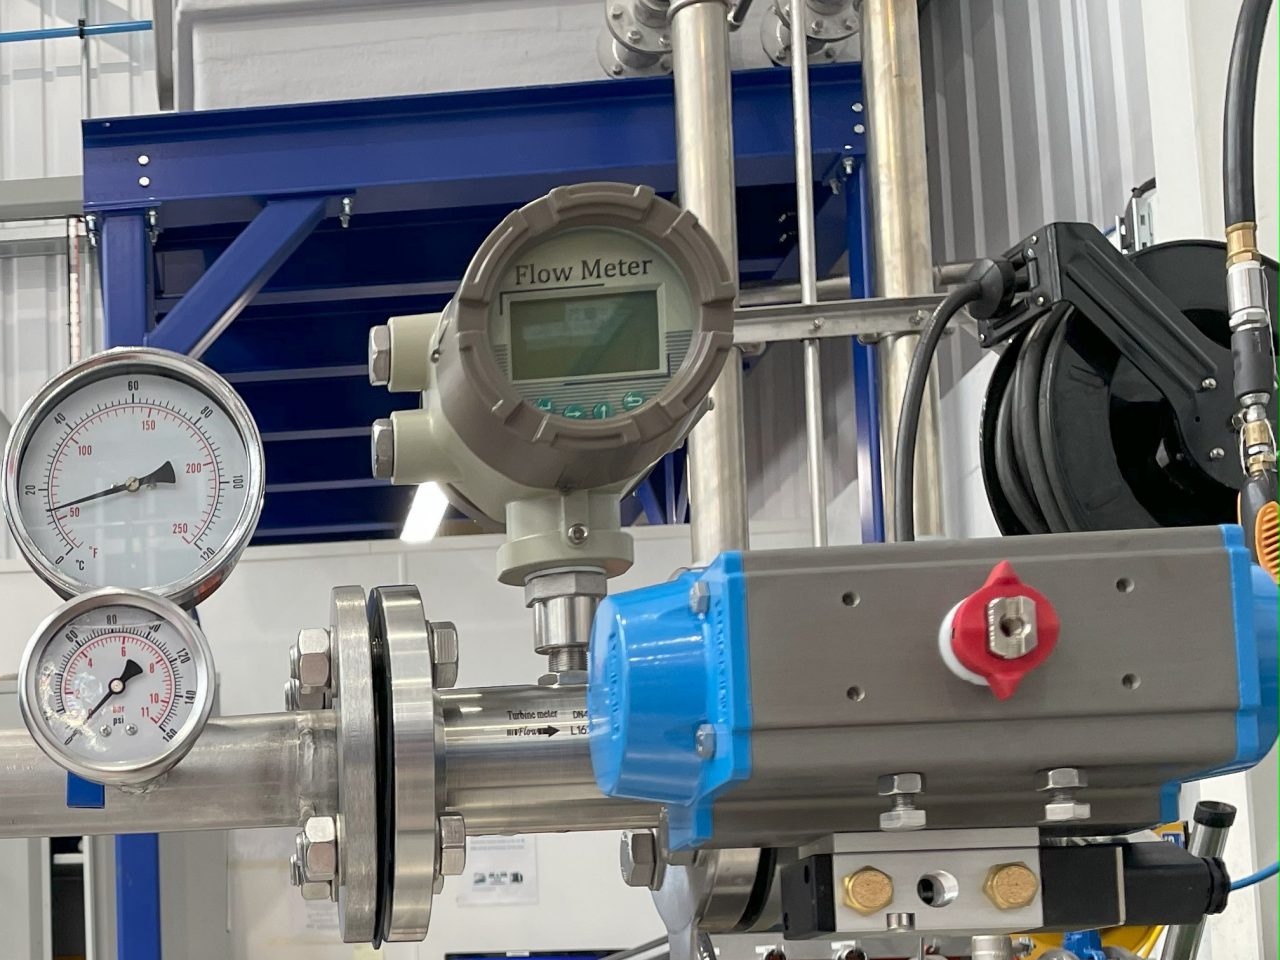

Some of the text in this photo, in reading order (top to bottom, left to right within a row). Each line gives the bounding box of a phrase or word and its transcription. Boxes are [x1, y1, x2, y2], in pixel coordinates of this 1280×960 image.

[515, 258, 652, 285] Flow Meter
[128, 380, 139, 391] 60
[199, 405, 214, 419] 80
[53, 412, 67, 425] 40
[141, 420, 156, 431] 150
[78, 445, 92, 456] 100
[186, 463, 202, 474] 200
[232, 474, 244, 489] 100
[25, 484, 36, 496] 20
[69, 507, 80, 518] 50
[172, 523, 188, 534] 250
[55, 555, 64, 565] 0
[200, 547, 216, 562] 120
[106, 615, 118, 625] 80
[65, 630, 78, 643] 60
[121, 647, 127, 657] 6
[176, 648, 191, 664] 120
[150, 693, 159, 704] 10
[185, 690, 196, 705] 140
[141, 707, 149, 717] 11
[507, 709, 558, 720] Turbine meter
[113, 716, 124, 727] psi
[162, 728, 178, 743] 160
[570, 725, 589, 736] L16
